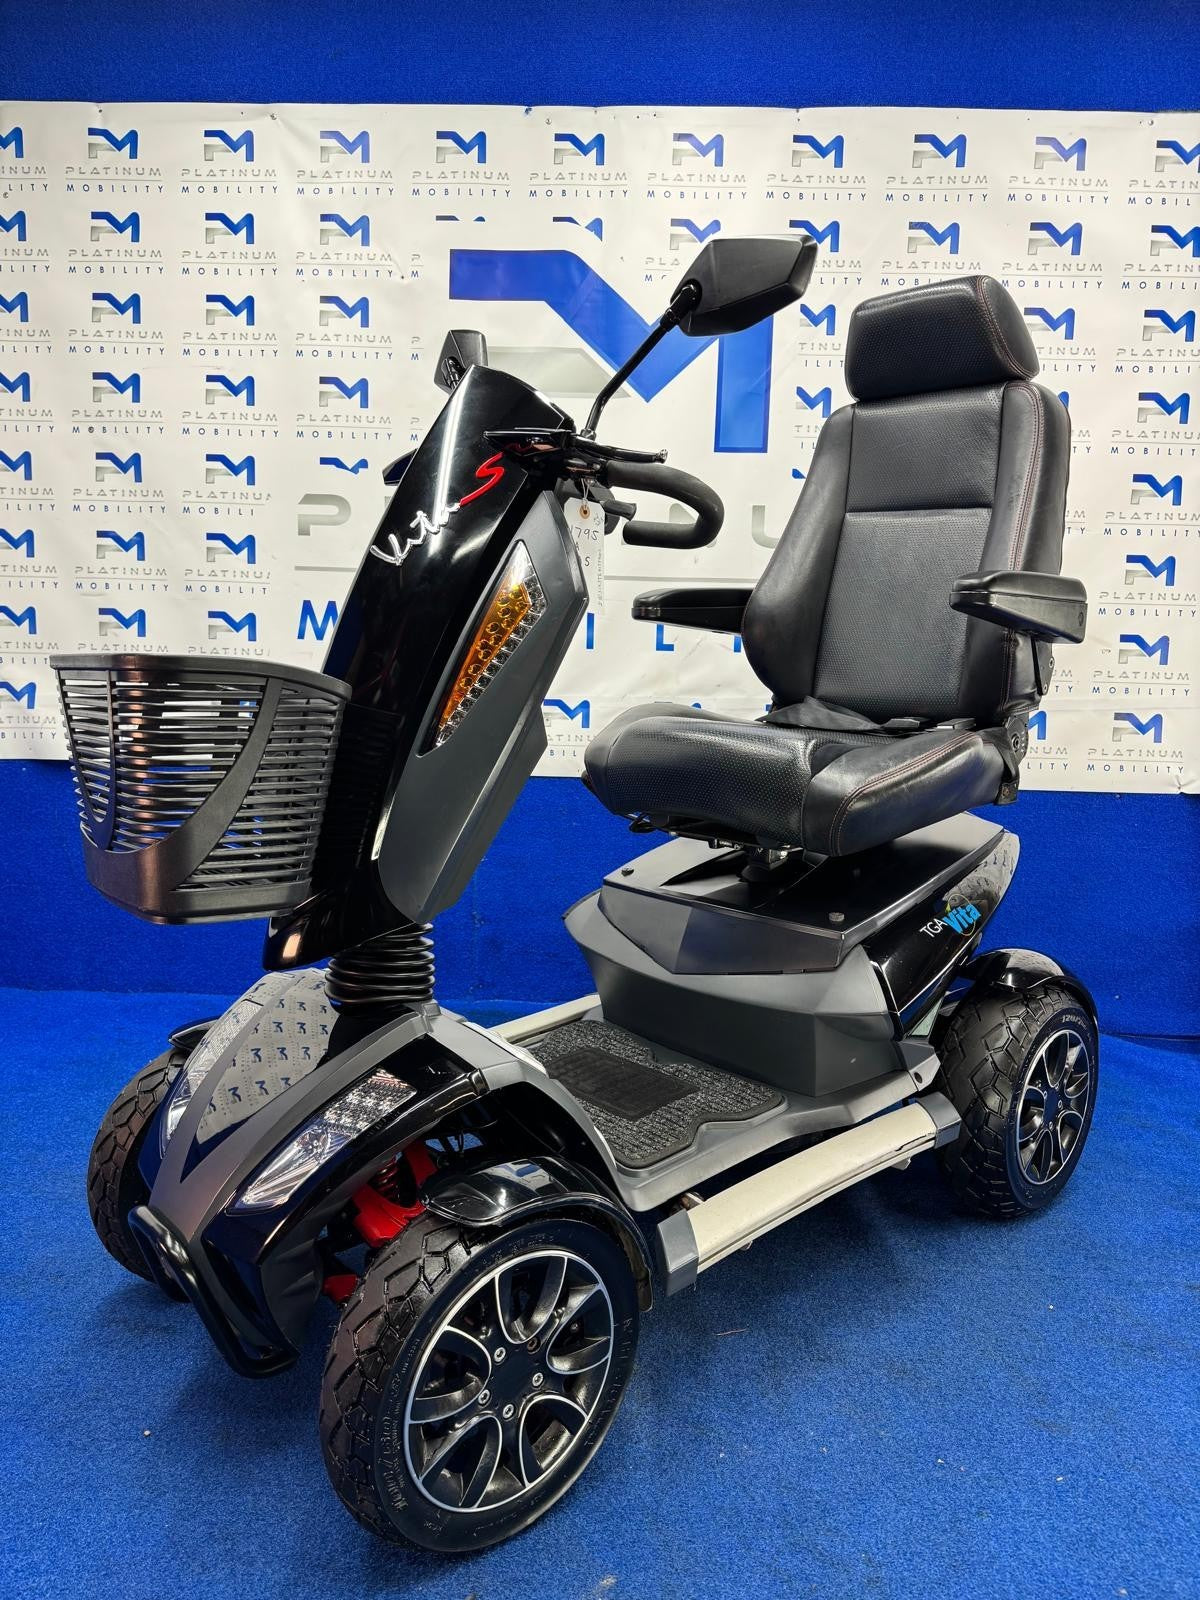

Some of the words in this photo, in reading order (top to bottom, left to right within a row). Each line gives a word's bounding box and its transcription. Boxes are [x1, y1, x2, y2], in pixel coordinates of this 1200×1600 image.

[66, 167, 161, 176] PLATINUM
[182, 169, 276, 177] PLATINUM
[297, 170, 392, 178] PLATINUM
[412, 171, 509, 180] PLATINUM
[530, 172, 627, 181] PLATINUM
[648, 173, 746, 182] PLATINUM
[767, 174, 865, 184] PLATINUM
[887, 176, 987, 184] PLATINUM
[1009, 176, 1108, 187] PLATINUM
[1129, 180, 1198, 189] PLATIN
[67, 184, 163, 193] MOBILITY
[297, 187, 393, 195] MOBILITY
[412, 188, 510, 197] MOBILITY
[530, 190, 627, 198] MOBILITY
[647, 190, 746, 199] MOBILITY
[766, 192, 866, 200] MOBILITY
[886, 194, 987, 202] MOBILITY
[1008, 194, 1108, 204] MOBILITY
[1128, 197, 1190, 206] MOBIL
[69, 249, 162, 257] PLATINUM
[182, 251, 276, 259] PLATINUM
[296, 252, 392, 261] PLATINUM
[69, 266, 163, 274] MOBILITY
[882, 261, 981, 270] PLATINUM
[1002, 263, 1102, 271] PLATINUM
[1124, 264, 1200, 272] PLATIN
[182, 267, 277, 276] MOBILITY
[296, 269, 392, 277] MOBILITY
[1122, 281, 1197, 290] MOBILI
[69, 329, 163, 339] PLATINUM
[183, 332, 276, 340] PLATINUM
[296, 334, 391, 344] PLATINUM
[2, 345, 51, 353] ILITY
[69, 346, 164, 355] MOBILITY
[183, 348, 278, 357] MOBILITY
[1037, 346, 1096, 357] TINUM
[296, 350, 392, 359] MOBILITY
[1043, 364, 1096, 372] ILITY
[1115, 365, 1200, 374] MOBILI
[72, 410, 162, 418] PLATINUM
[182, 411, 277, 421] PLATINUM
[297, 414, 391, 424] PLATINUM
[72, 426, 163, 434] MOBILITY
[182, 428, 278, 437] MOBILITY
[297, 431, 392, 440] MOBILITY
[1111, 447, 1195, 456] MOBILIT
[0, 487, 53, 495] TINUM
[73, 489, 164, 497] PLATINUM
[7, 503, 55, 511] ILITY
[73, 505, 165, 513] MOBILITY
[183, 507, 253, 516] MOBILI
[1, 565, 56, 573] TINUM
[75, 566, 167, 575] PLATINUM
[76, 582, 168, 591] MOBILITY
[186, 585, 266, 594] MOBILIT
[1098, 591, 1197, 602] PLATINUM
[1099, 608, 1196, 617] MOBILITY
[0, 641, 59, 650] TINUM
[78, 643, 167, 652] PLATINUM
[0, 657, 48, 665] BILIT
[1093, 670, 1190, 681] PLATINUM
[1092, 686, 1189, 696] MOBILITY
[0, 715, 56, 724] TINUM
[1088, 748, 1182, 758] PLATINUM
[1087, 764, 1183, 773] MOBILITY
[919, 918, 949, 938] TGA
[941, 903, 982, 935] Vita
